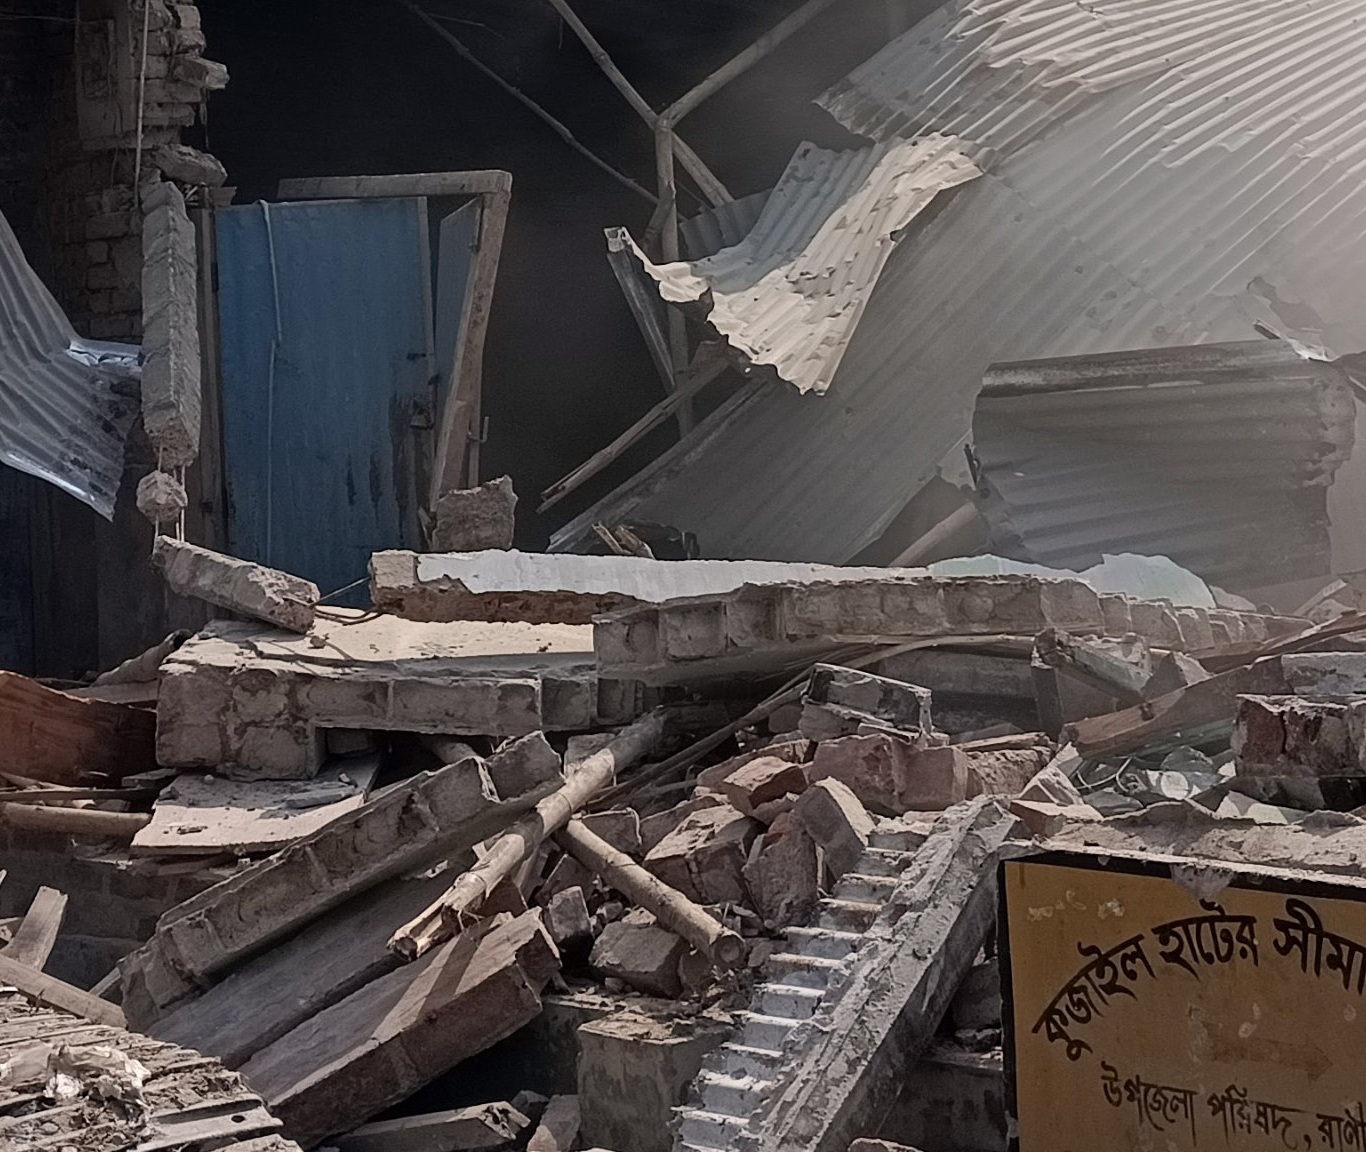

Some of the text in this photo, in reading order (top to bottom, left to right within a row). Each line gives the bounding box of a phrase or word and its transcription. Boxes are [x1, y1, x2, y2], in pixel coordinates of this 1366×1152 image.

[1032, 941, 1156, 1061] কুজাইল
[1151, 898, 1259, 982] হাটের
[1101, 1061, 1197, 1146] উপজেলা
